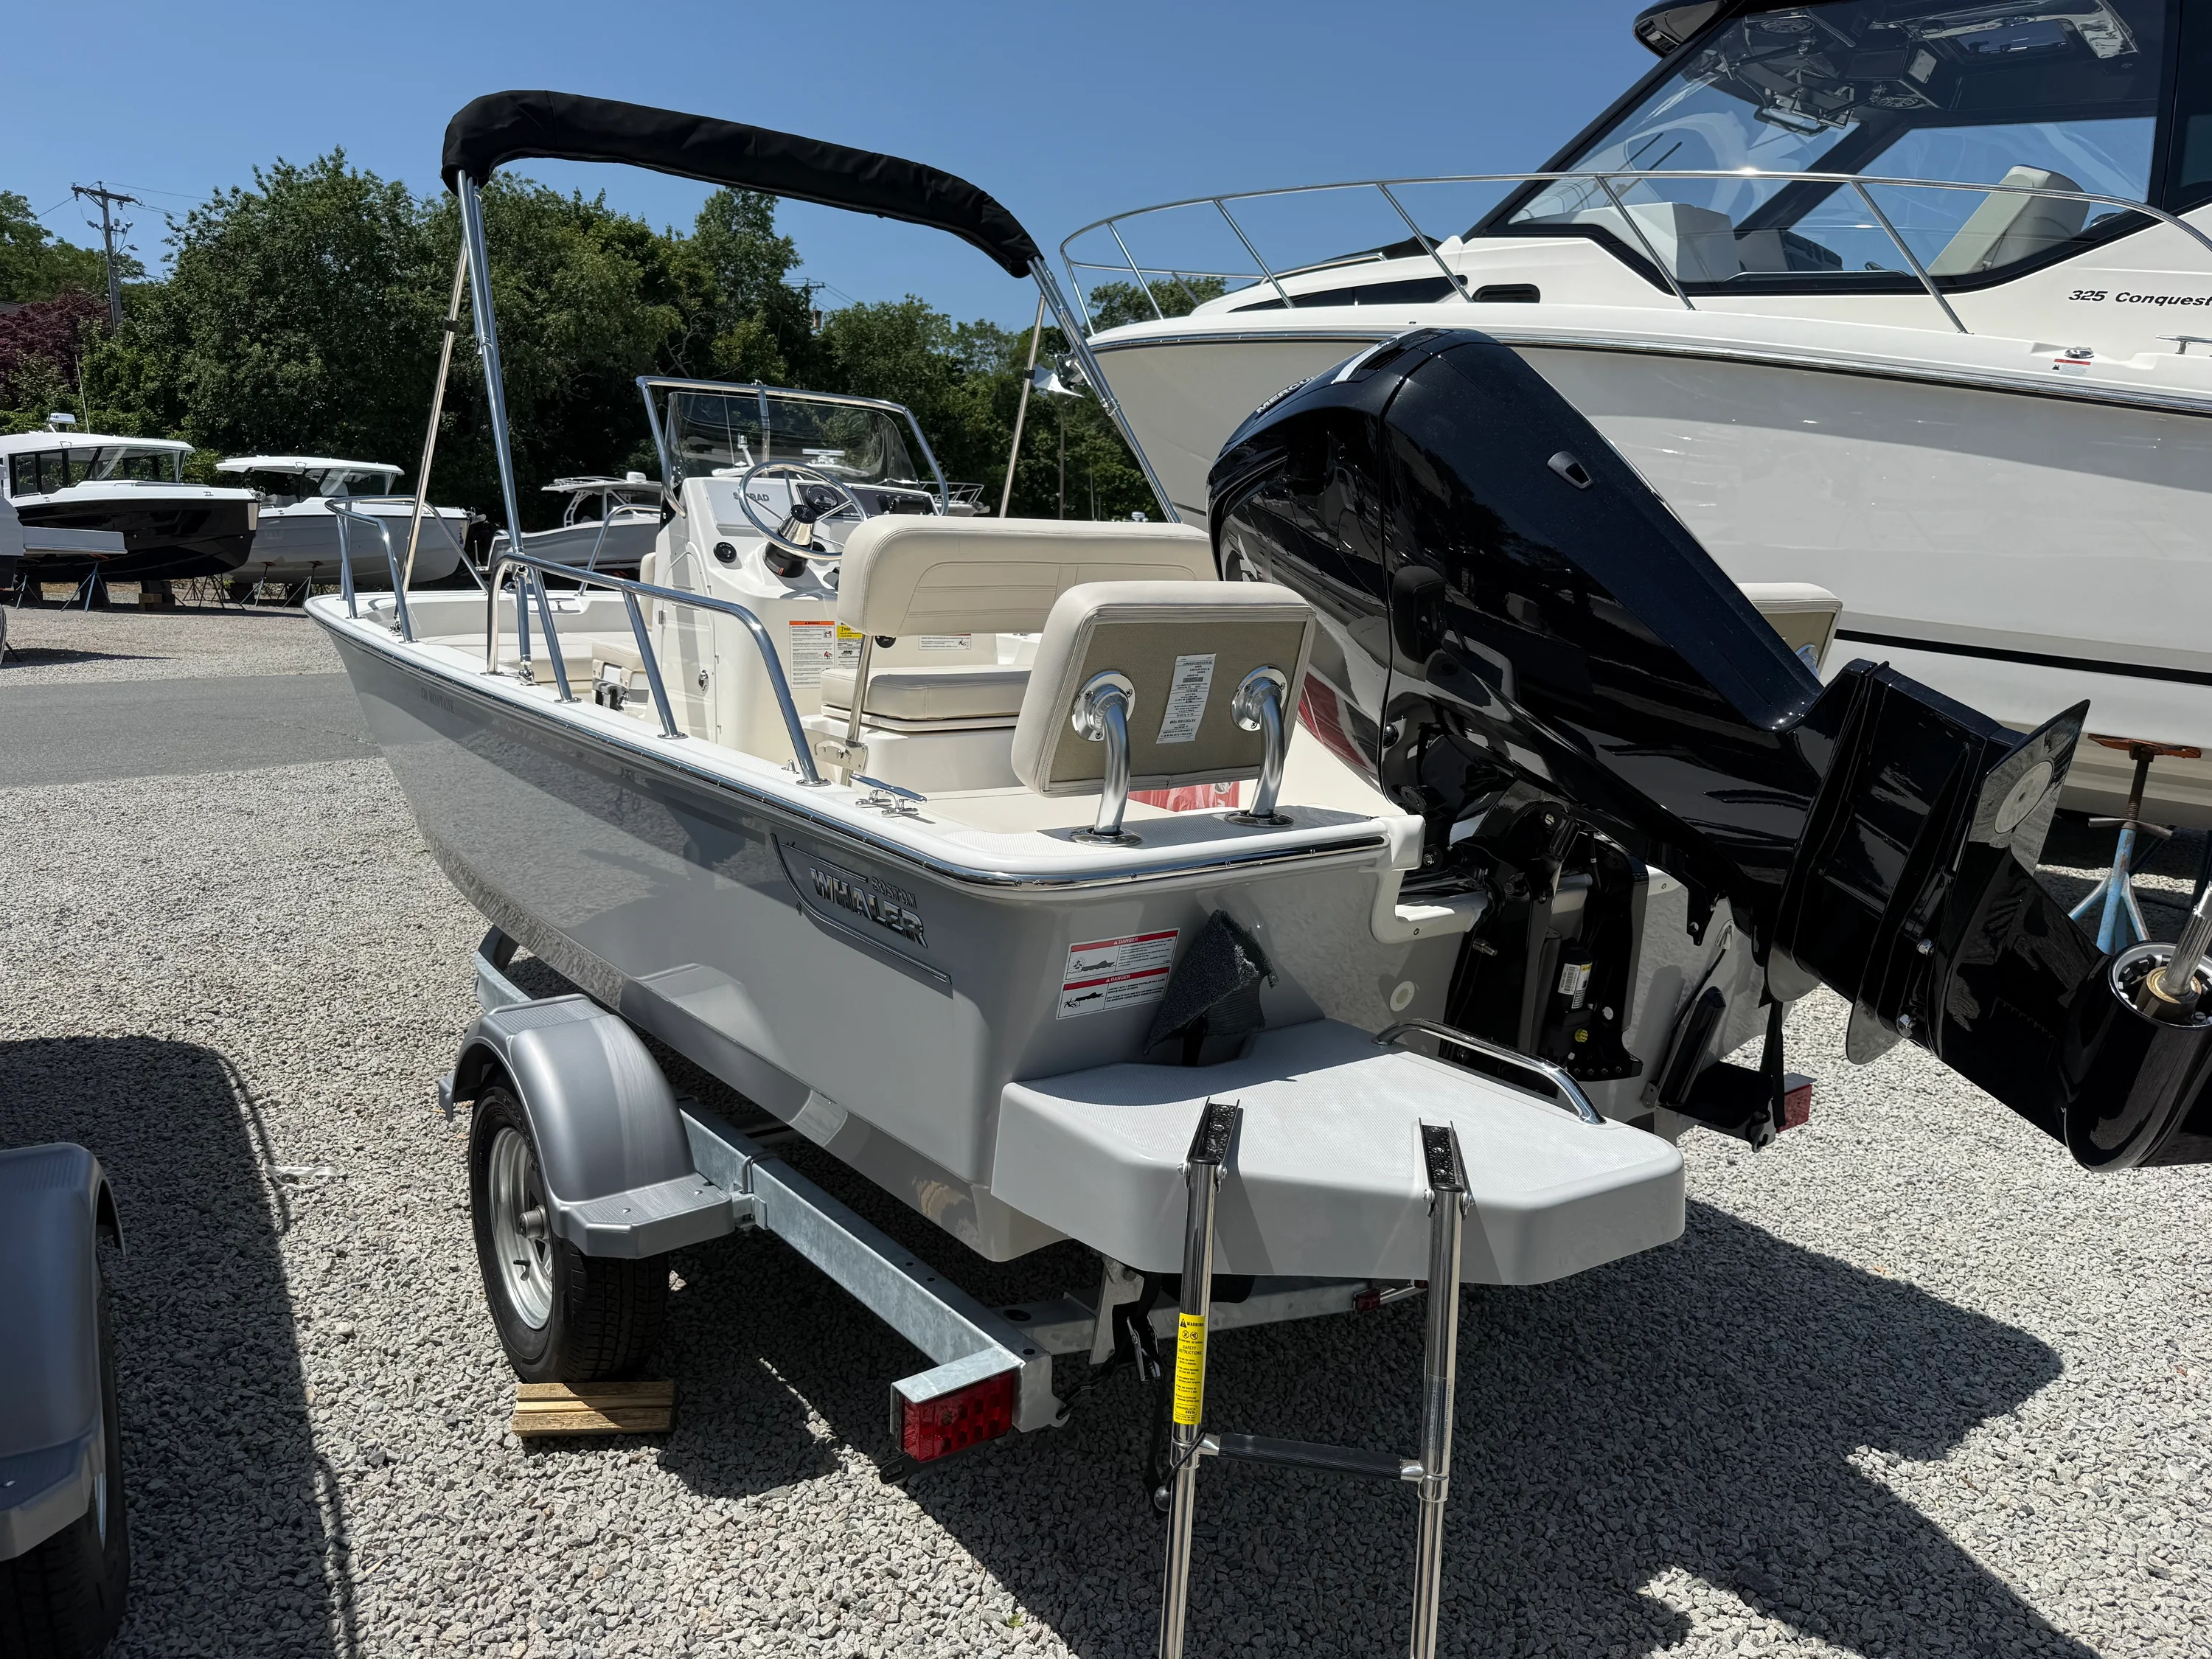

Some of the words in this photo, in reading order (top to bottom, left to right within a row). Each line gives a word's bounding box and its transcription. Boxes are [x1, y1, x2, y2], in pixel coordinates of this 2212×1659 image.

[2068, 290, 2108, 302] 325
[2115, 292, 2212, 307] Conquest
[871, 876, 917, 909] BOSTON
[810, 866, 928, 949] WHALER
[1118, 936, 1138, 945] DANGER
[1110, 974, 1130, 982] DANGER
